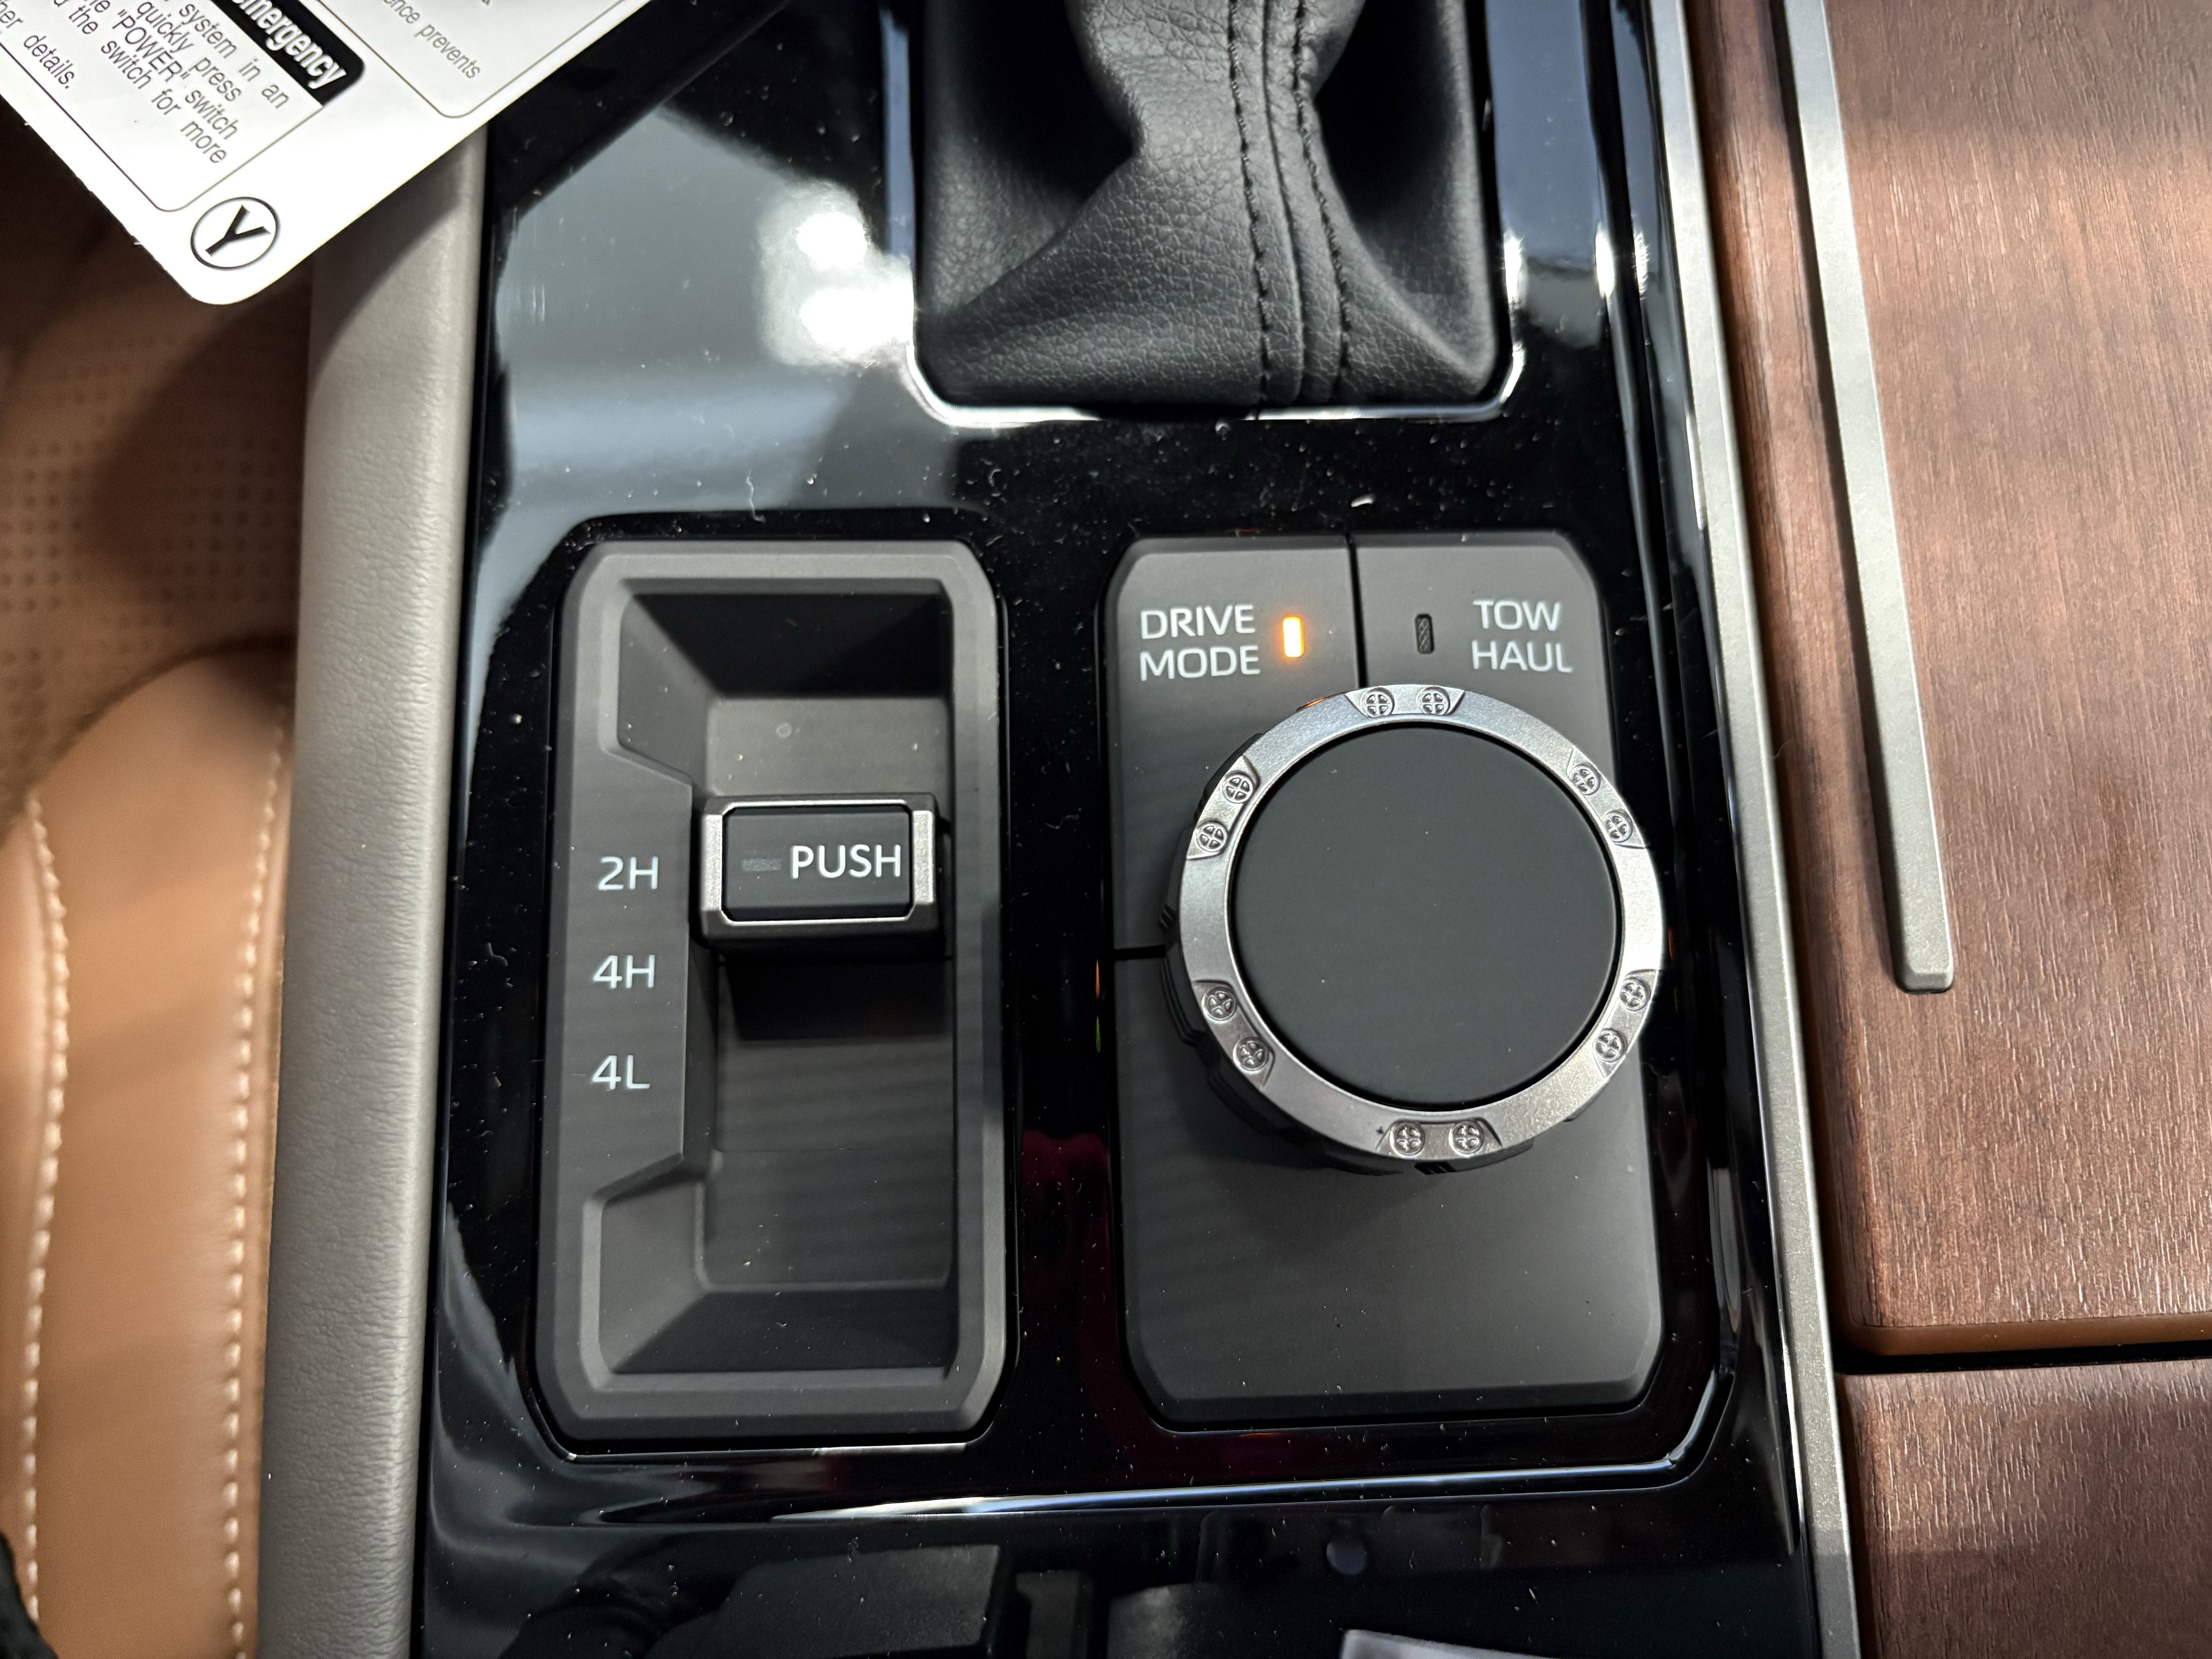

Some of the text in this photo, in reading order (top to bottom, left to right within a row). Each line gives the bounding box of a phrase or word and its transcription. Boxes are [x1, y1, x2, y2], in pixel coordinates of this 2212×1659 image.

[23, 35, 75, 89] details.
[136, 2, 242, 101] quickly press
[179, 4, 289, 109] system in an
[231, 0, 347, 89] mergency
[414, 24, 480, 79] prevents
[69, 5, 98, 34] the
[101, 41, 152, 89] switch
[151, 89, 182, 115] for
[180, 119, 228, 164] more
[112, 9, 238, 140] "POWER" switch
[204, 204, 272, 257] Y
[1140, 604, 1256, 640] DRIVE
[1472, 599, 1563, 632] TOW
[1140, 645, 1261, 681] MODE
[1472, 640, 1573, 673] HAUL
[597, 856, 659, 892] 2H
[790, 844, 902, 879] PUSH
[592, 955, 655, 989] 4H
[591, 1055, 651, 1090] 4L
